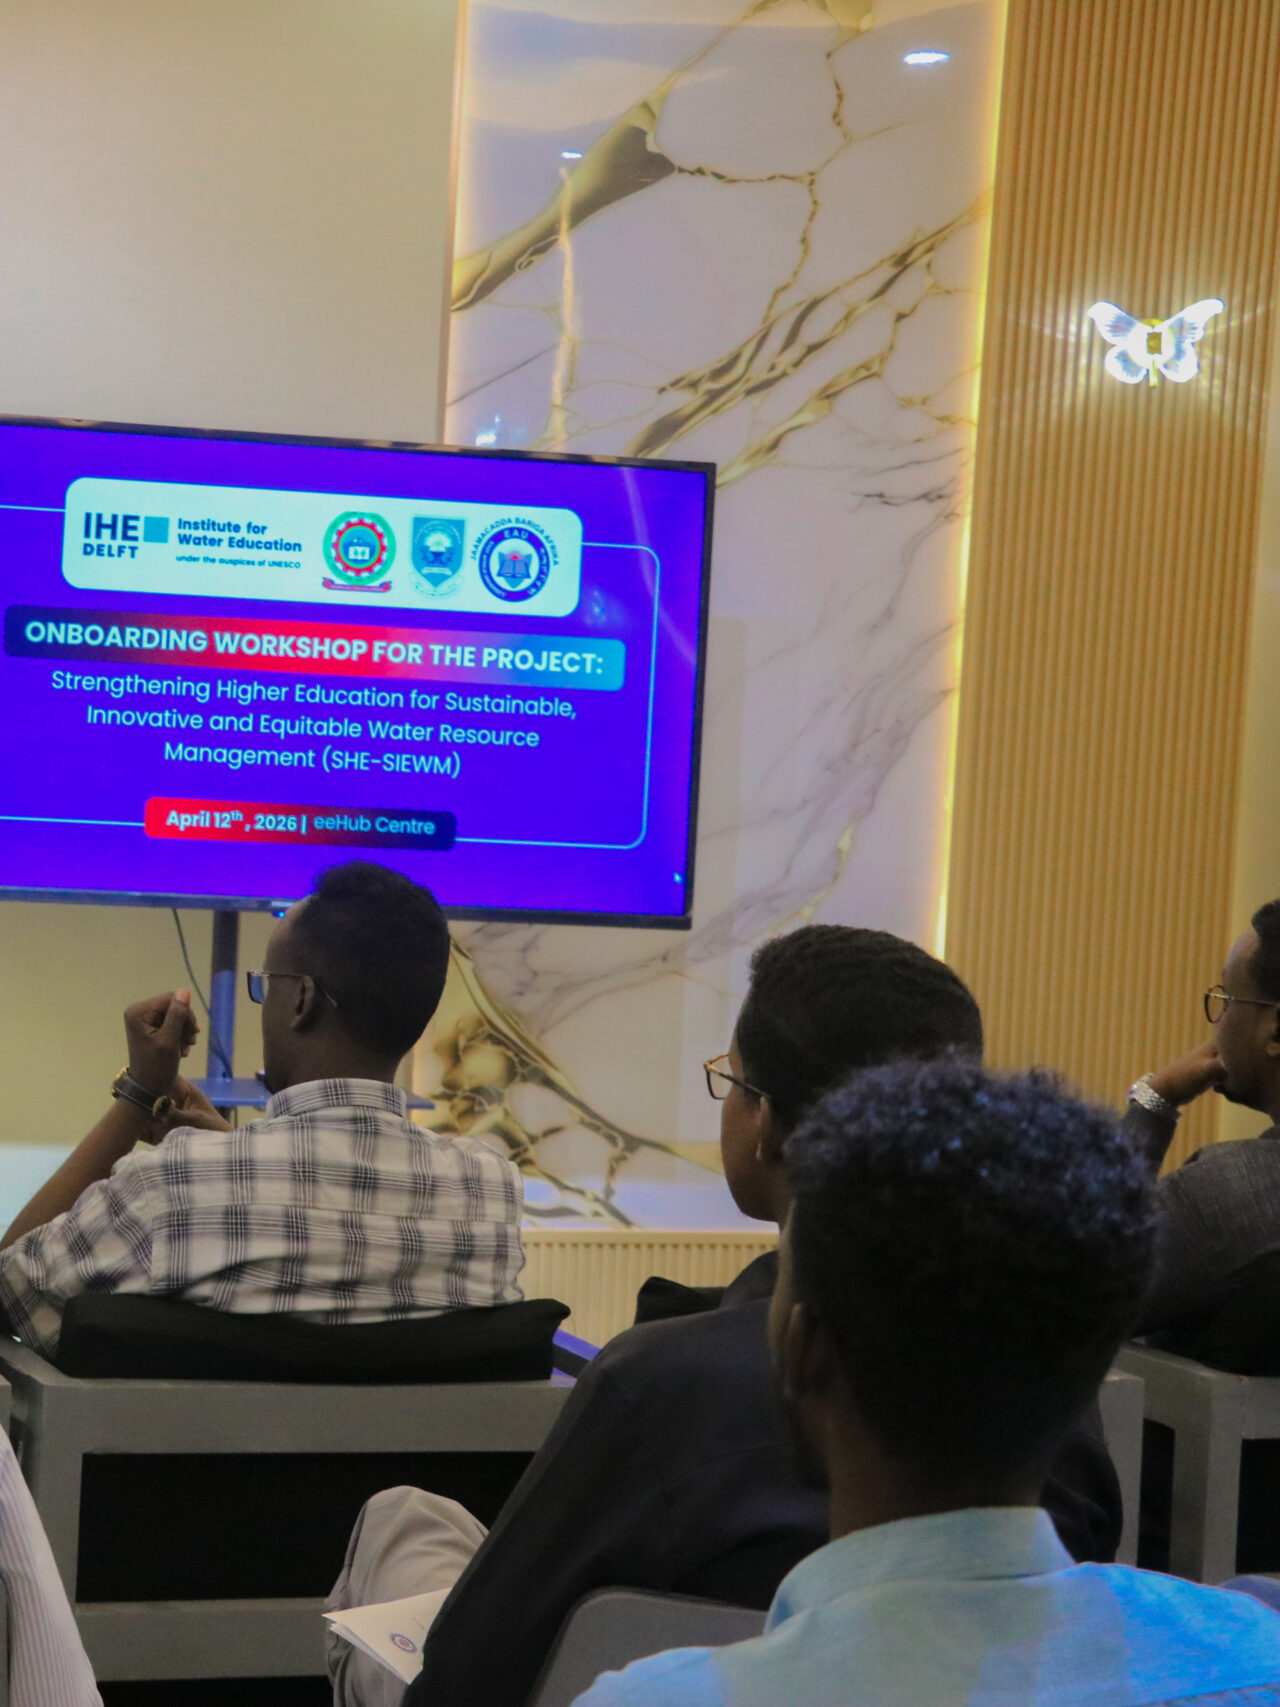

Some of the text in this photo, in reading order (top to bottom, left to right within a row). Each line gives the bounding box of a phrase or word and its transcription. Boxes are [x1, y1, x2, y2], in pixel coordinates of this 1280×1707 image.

[83, 512, 140, 542] IHE
[178, 518, 268, 535] Institute for
[503, 529, 529, 538] EAU
[82, 543, 139, 559] DELFT
[177, 533, 302, 552] Water Education
[175, 555, 302, 569] under the auspices of UNESCO
[25, 621, 604, 676] ONBOARDING WORKSHOP FOR THE PROJECT:
[52, 671, 576, 719] Strengthening Higher Education for Sustainable,
[87, 706, 540, 747] Innovative and Equitable Water Resource
[165, 742, 460, 778] Management (SHE-SIEWM)
[166, 811, 210, 831] April
[313, 815, 371, 831] eeHub
[375, 817, 435, 834] Centre
